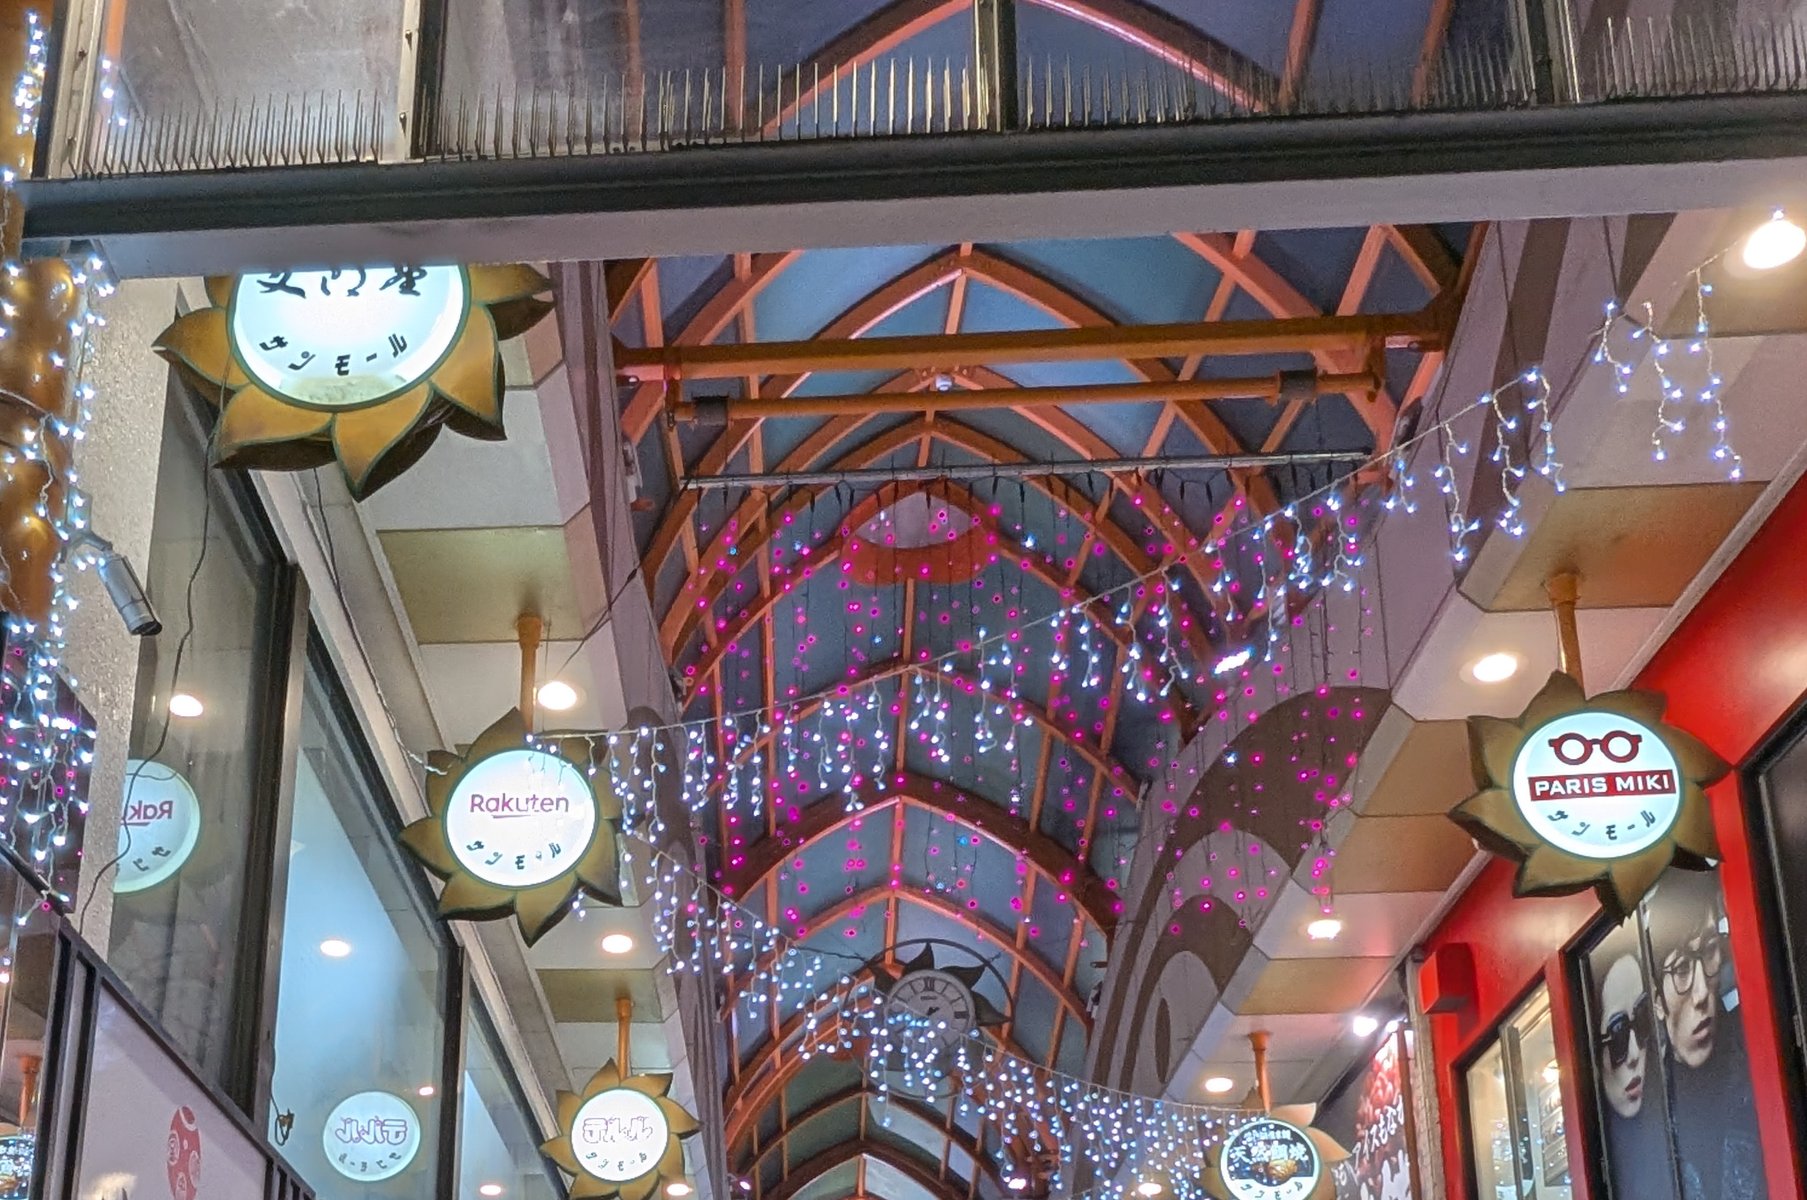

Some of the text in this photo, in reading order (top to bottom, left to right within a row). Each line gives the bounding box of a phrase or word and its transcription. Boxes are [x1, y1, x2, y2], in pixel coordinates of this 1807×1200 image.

[259, 333, 408, 376] サンモール
[1534, 773, 1670, 797] PARIS MIKI
[470, 793, 569, 813] Rakuten
[1548, 810, 1656, 840] サンモール
[466, 841, 561, 870] サンモール
